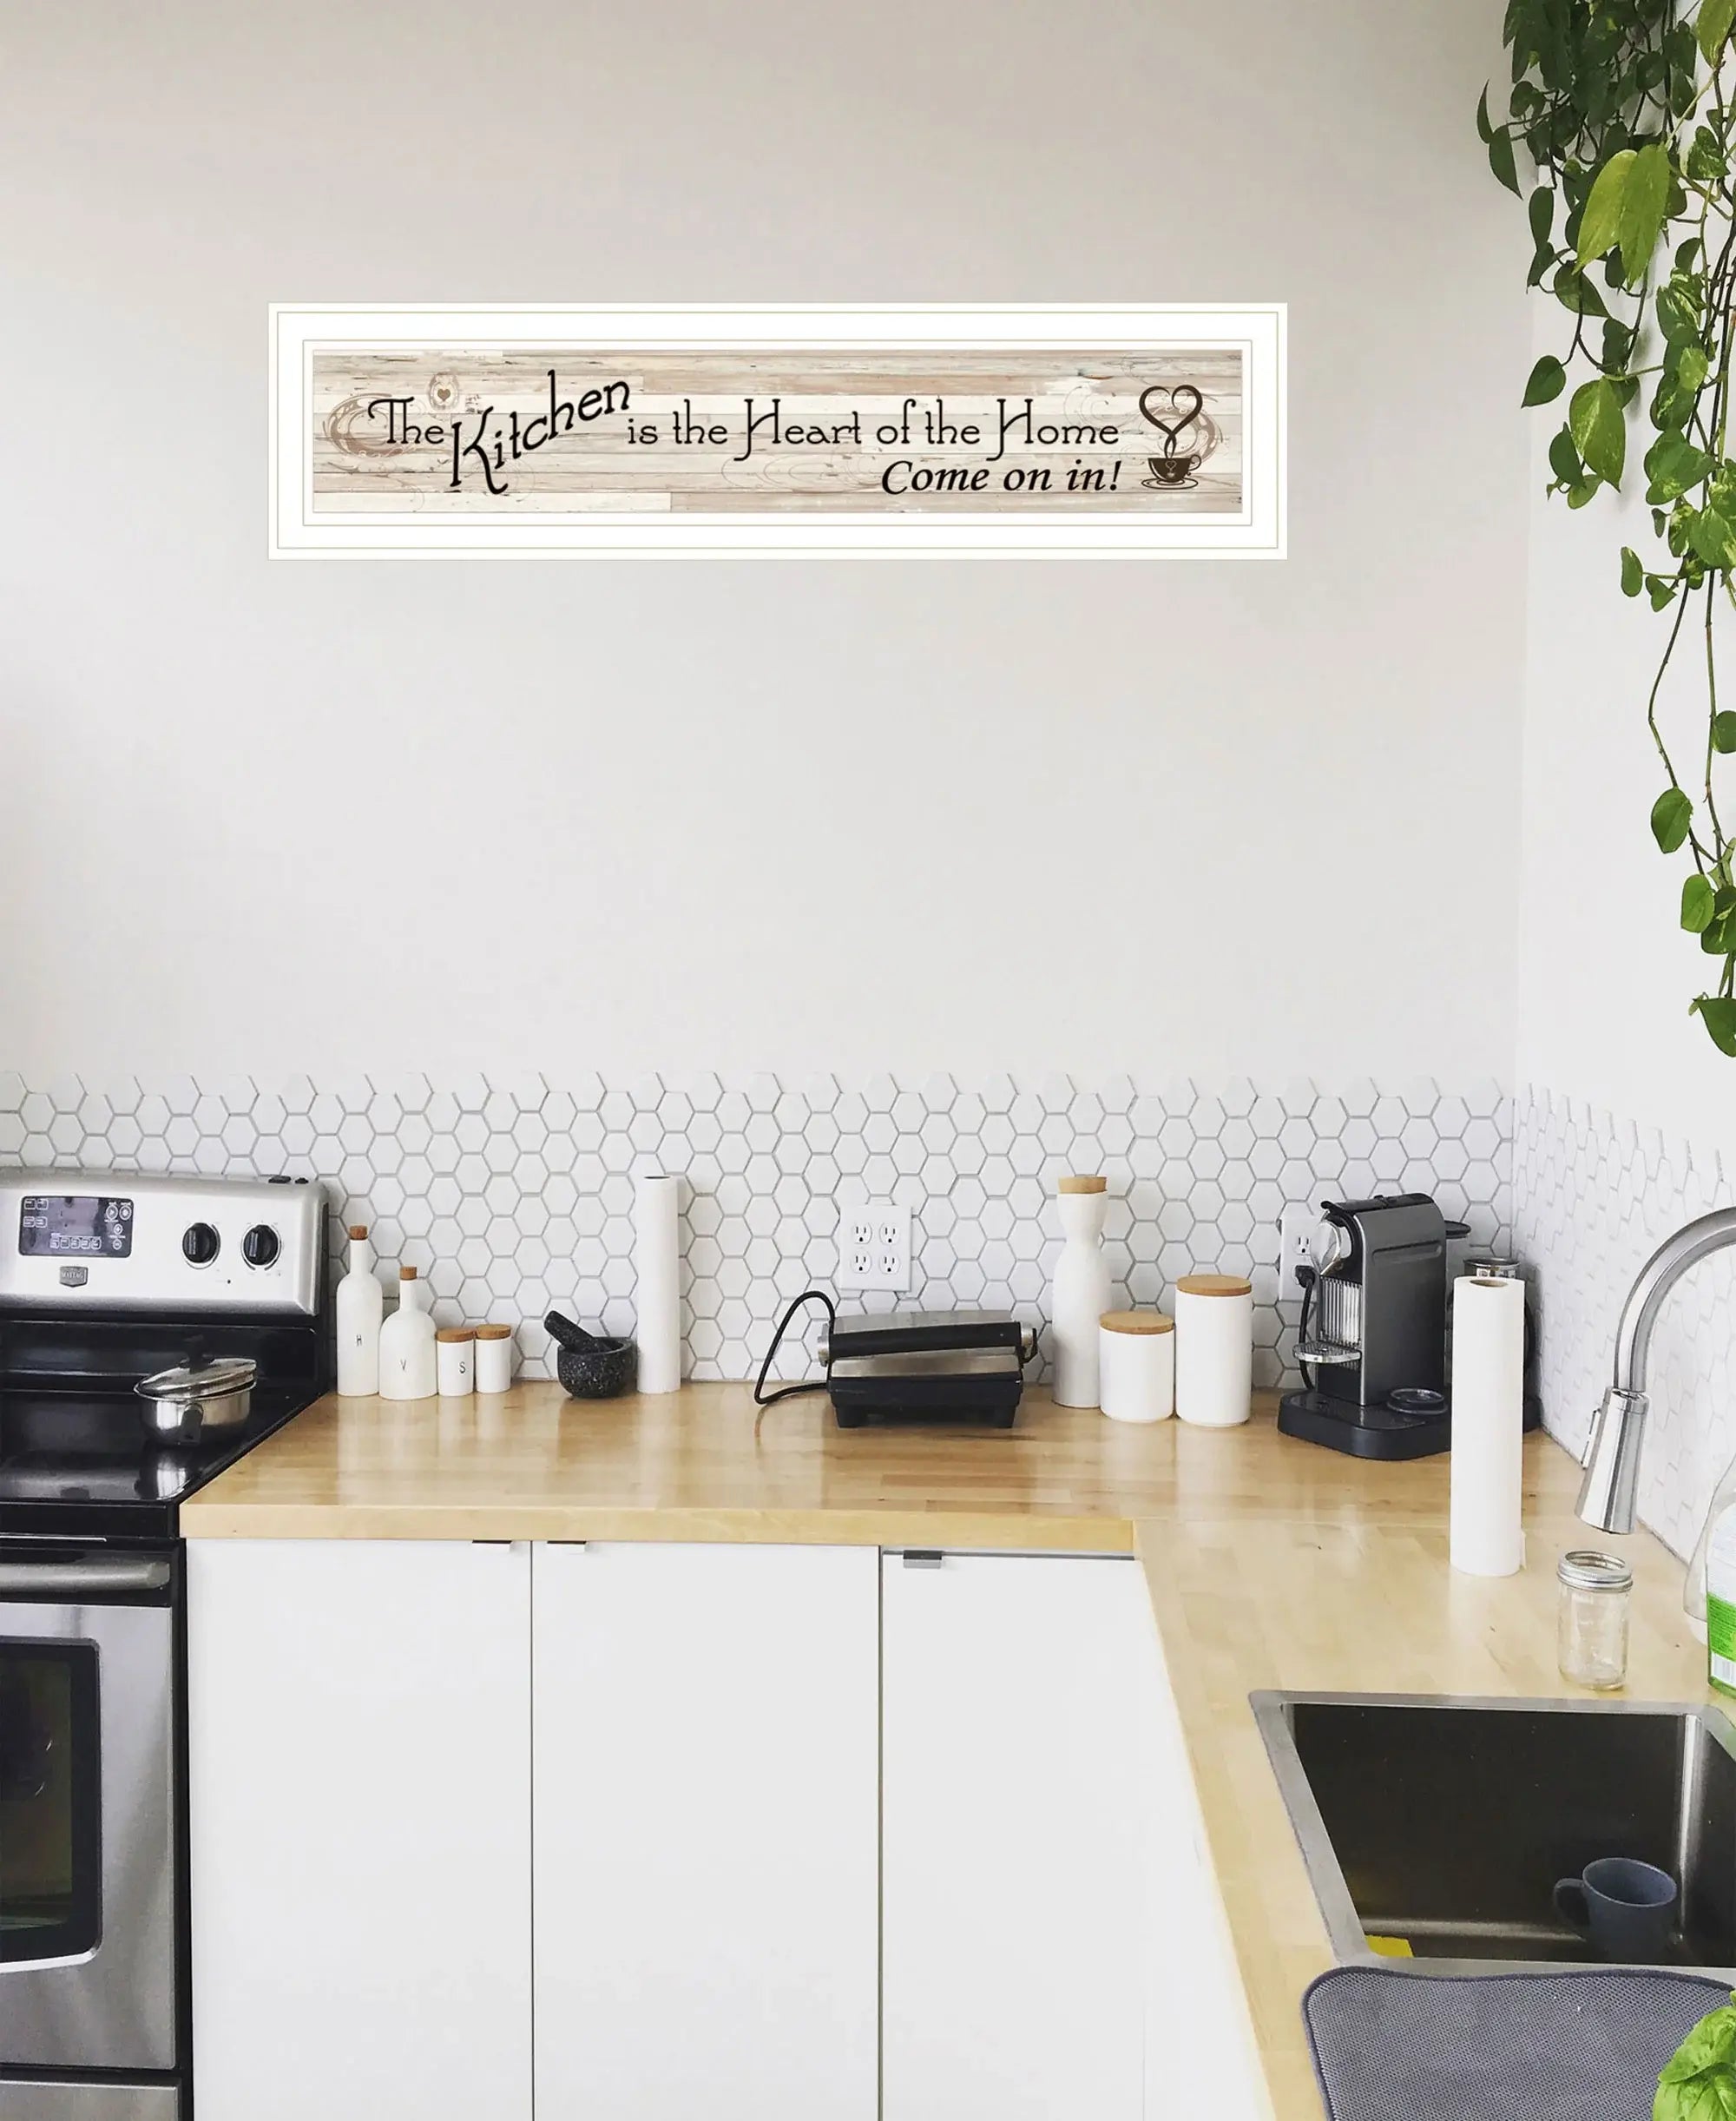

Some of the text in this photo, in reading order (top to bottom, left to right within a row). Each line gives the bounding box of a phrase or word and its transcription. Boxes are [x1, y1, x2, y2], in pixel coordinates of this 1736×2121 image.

[368, 370, 1120, 495] The Kitchen is the Heart of the Home
[881, 458, 1122, 495] Come on in!
[355, 1334, 363, 1347] H
[399, 1359, 407, 1371] V
[458, 1361, 466, 1374] S
